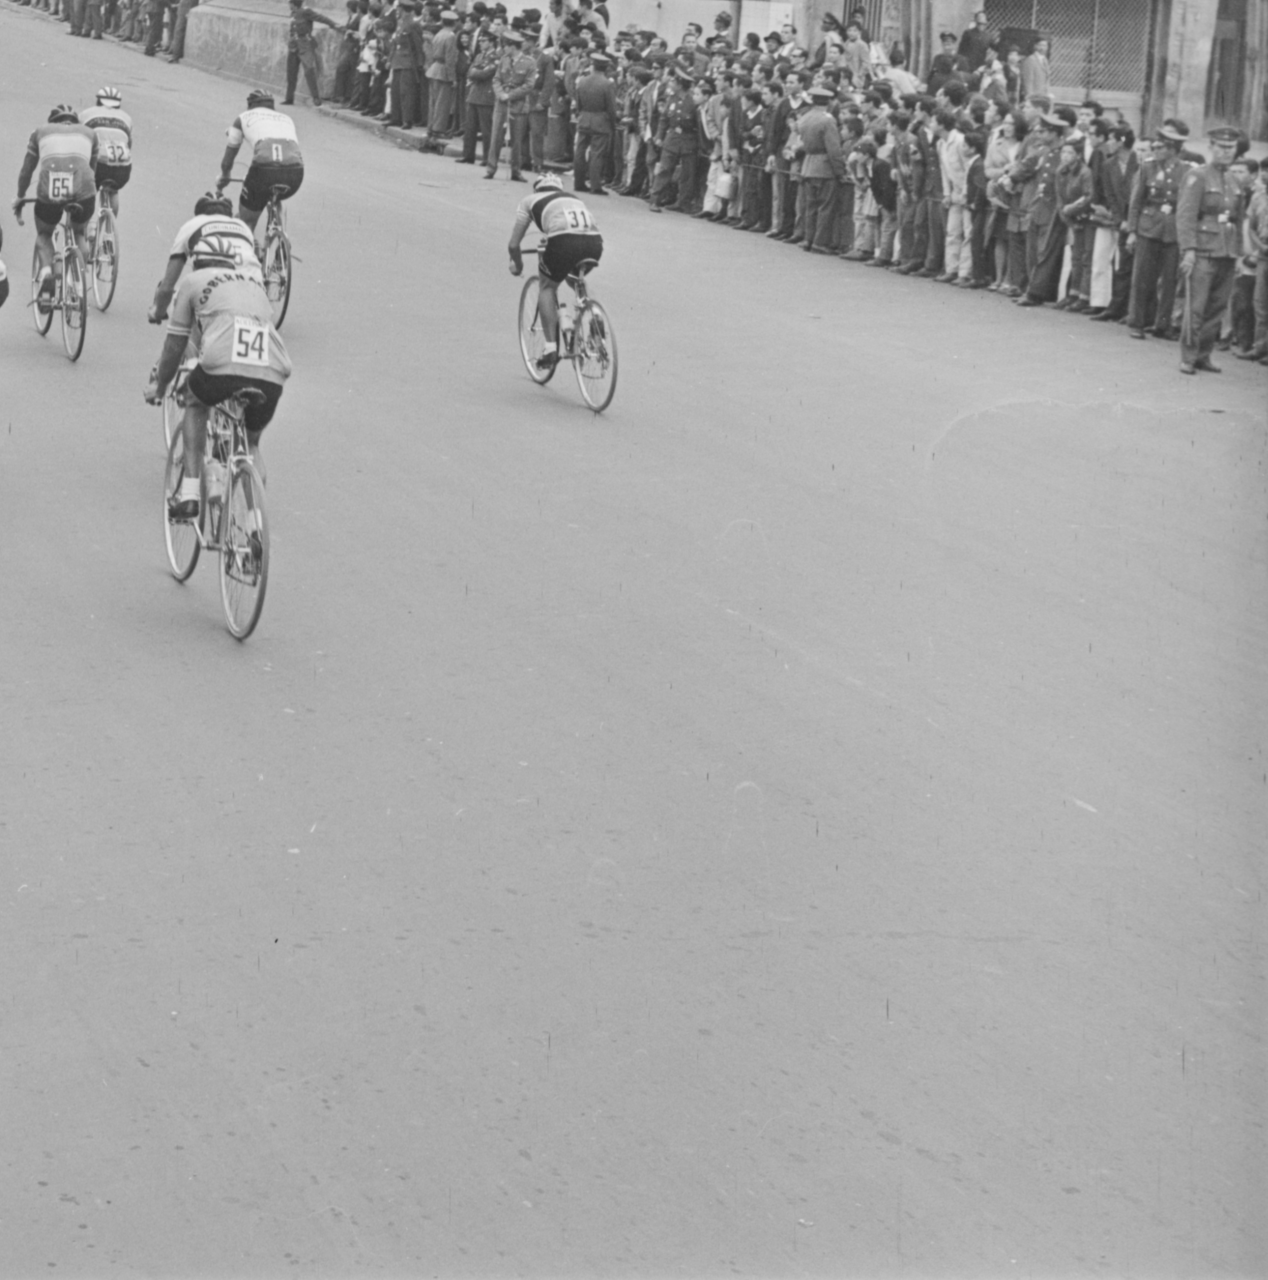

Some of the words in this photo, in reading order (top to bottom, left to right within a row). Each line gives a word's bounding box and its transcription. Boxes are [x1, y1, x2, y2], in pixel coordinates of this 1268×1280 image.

[107, 145, 125, 163] 32
[52, 177, 70, 198] 65
[568, 210, 589, 229] 31
[236, 328, 265, 360] 54
